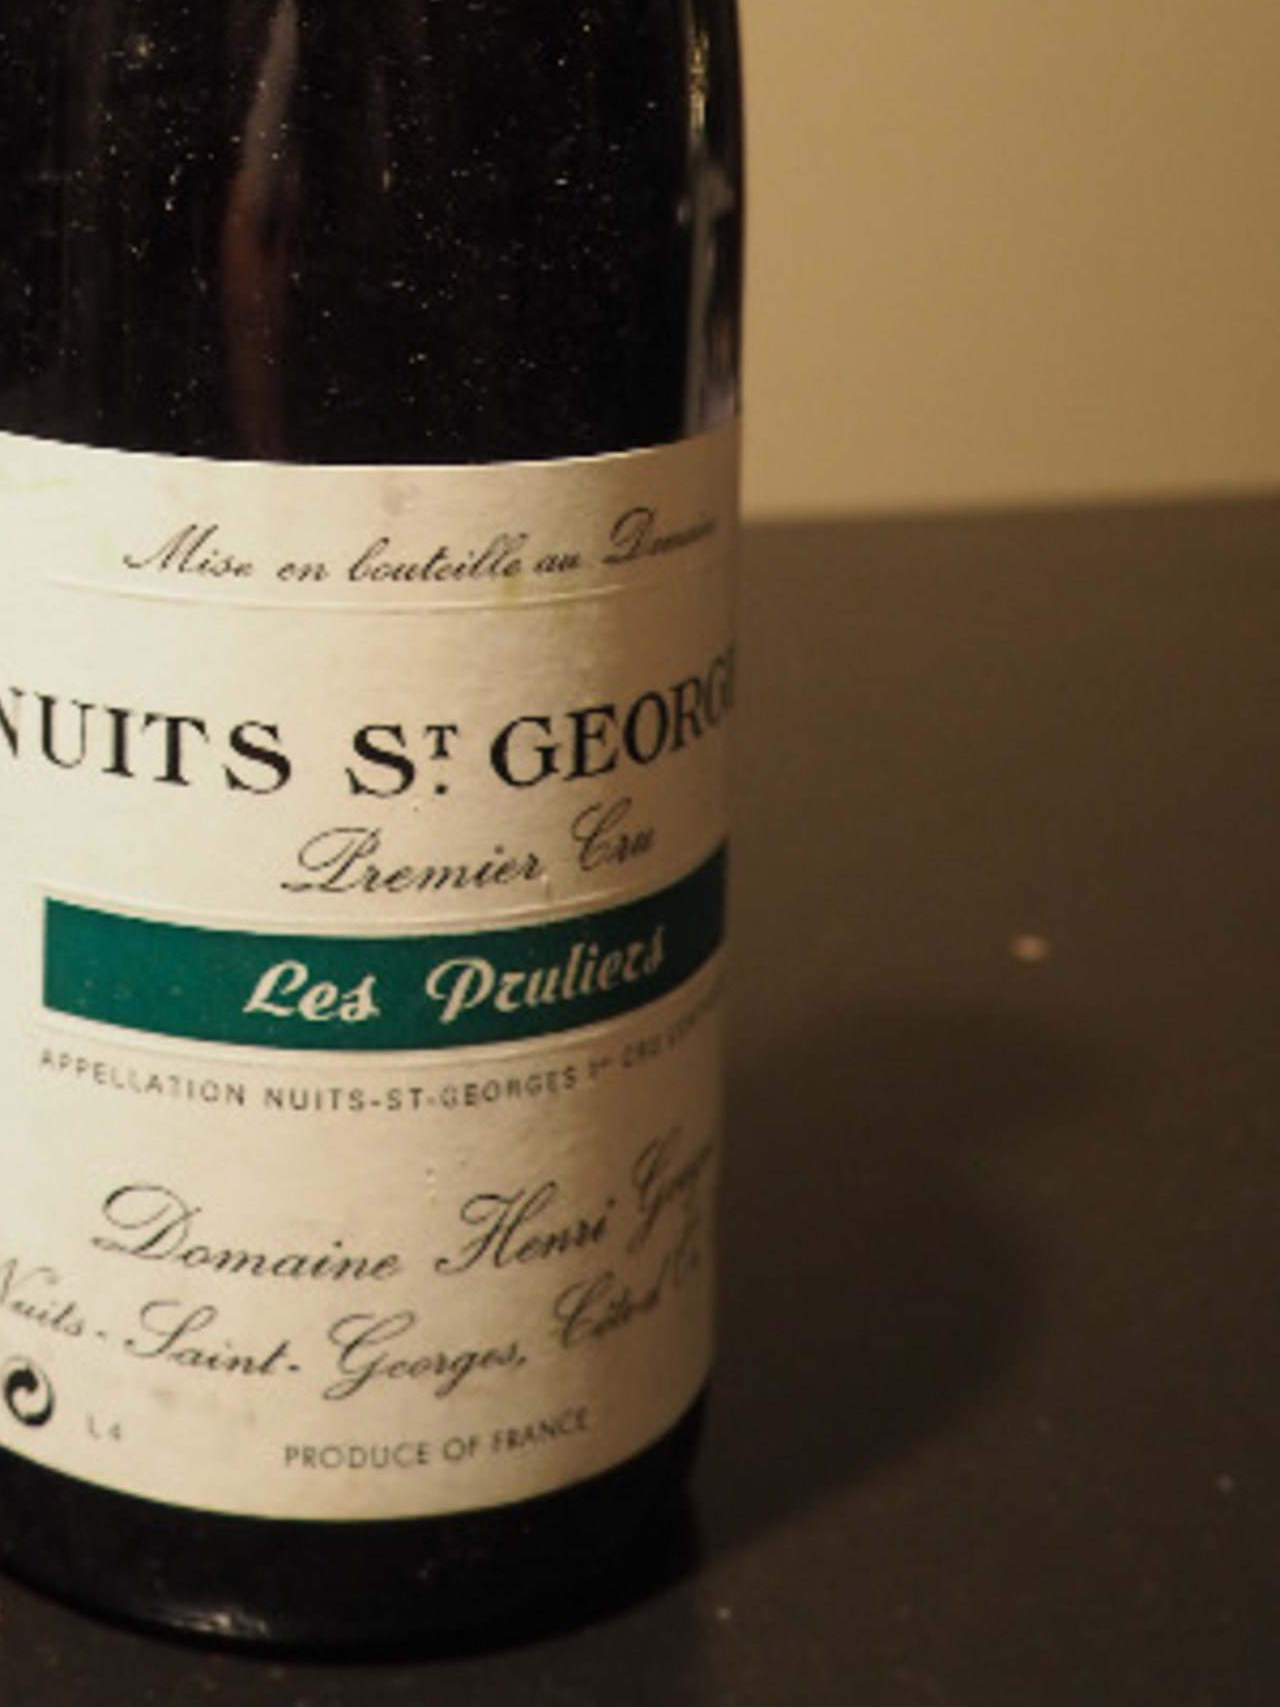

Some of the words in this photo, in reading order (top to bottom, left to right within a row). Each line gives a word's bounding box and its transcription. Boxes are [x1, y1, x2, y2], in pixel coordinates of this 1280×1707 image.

[122, 523, 256, 579] Mise
[276, 555, 330, 584] en
[346, 532, 529, 584] bouteille
[533, 552, 583, 575] au
[279, 826, 548, 894] Premier
[570, 796, 658, 874] Cru
[242, 959, 382, 1023] Les
[425, 924, 668, 1026] Pruliers
[40, 1049, 246, 1108] APPELLATION
[263, 1065, 578, 1113] NUITS-ST-GEORGES
[89, 1183, 402, 1282] Domaine
[433, 1179, 618, 1274] Henri
[283, 1441, 430, 1471] PRODUCE
[442, 1434, 480, 1464] OF
[490, 1406, 591, 1455] FRANCE
